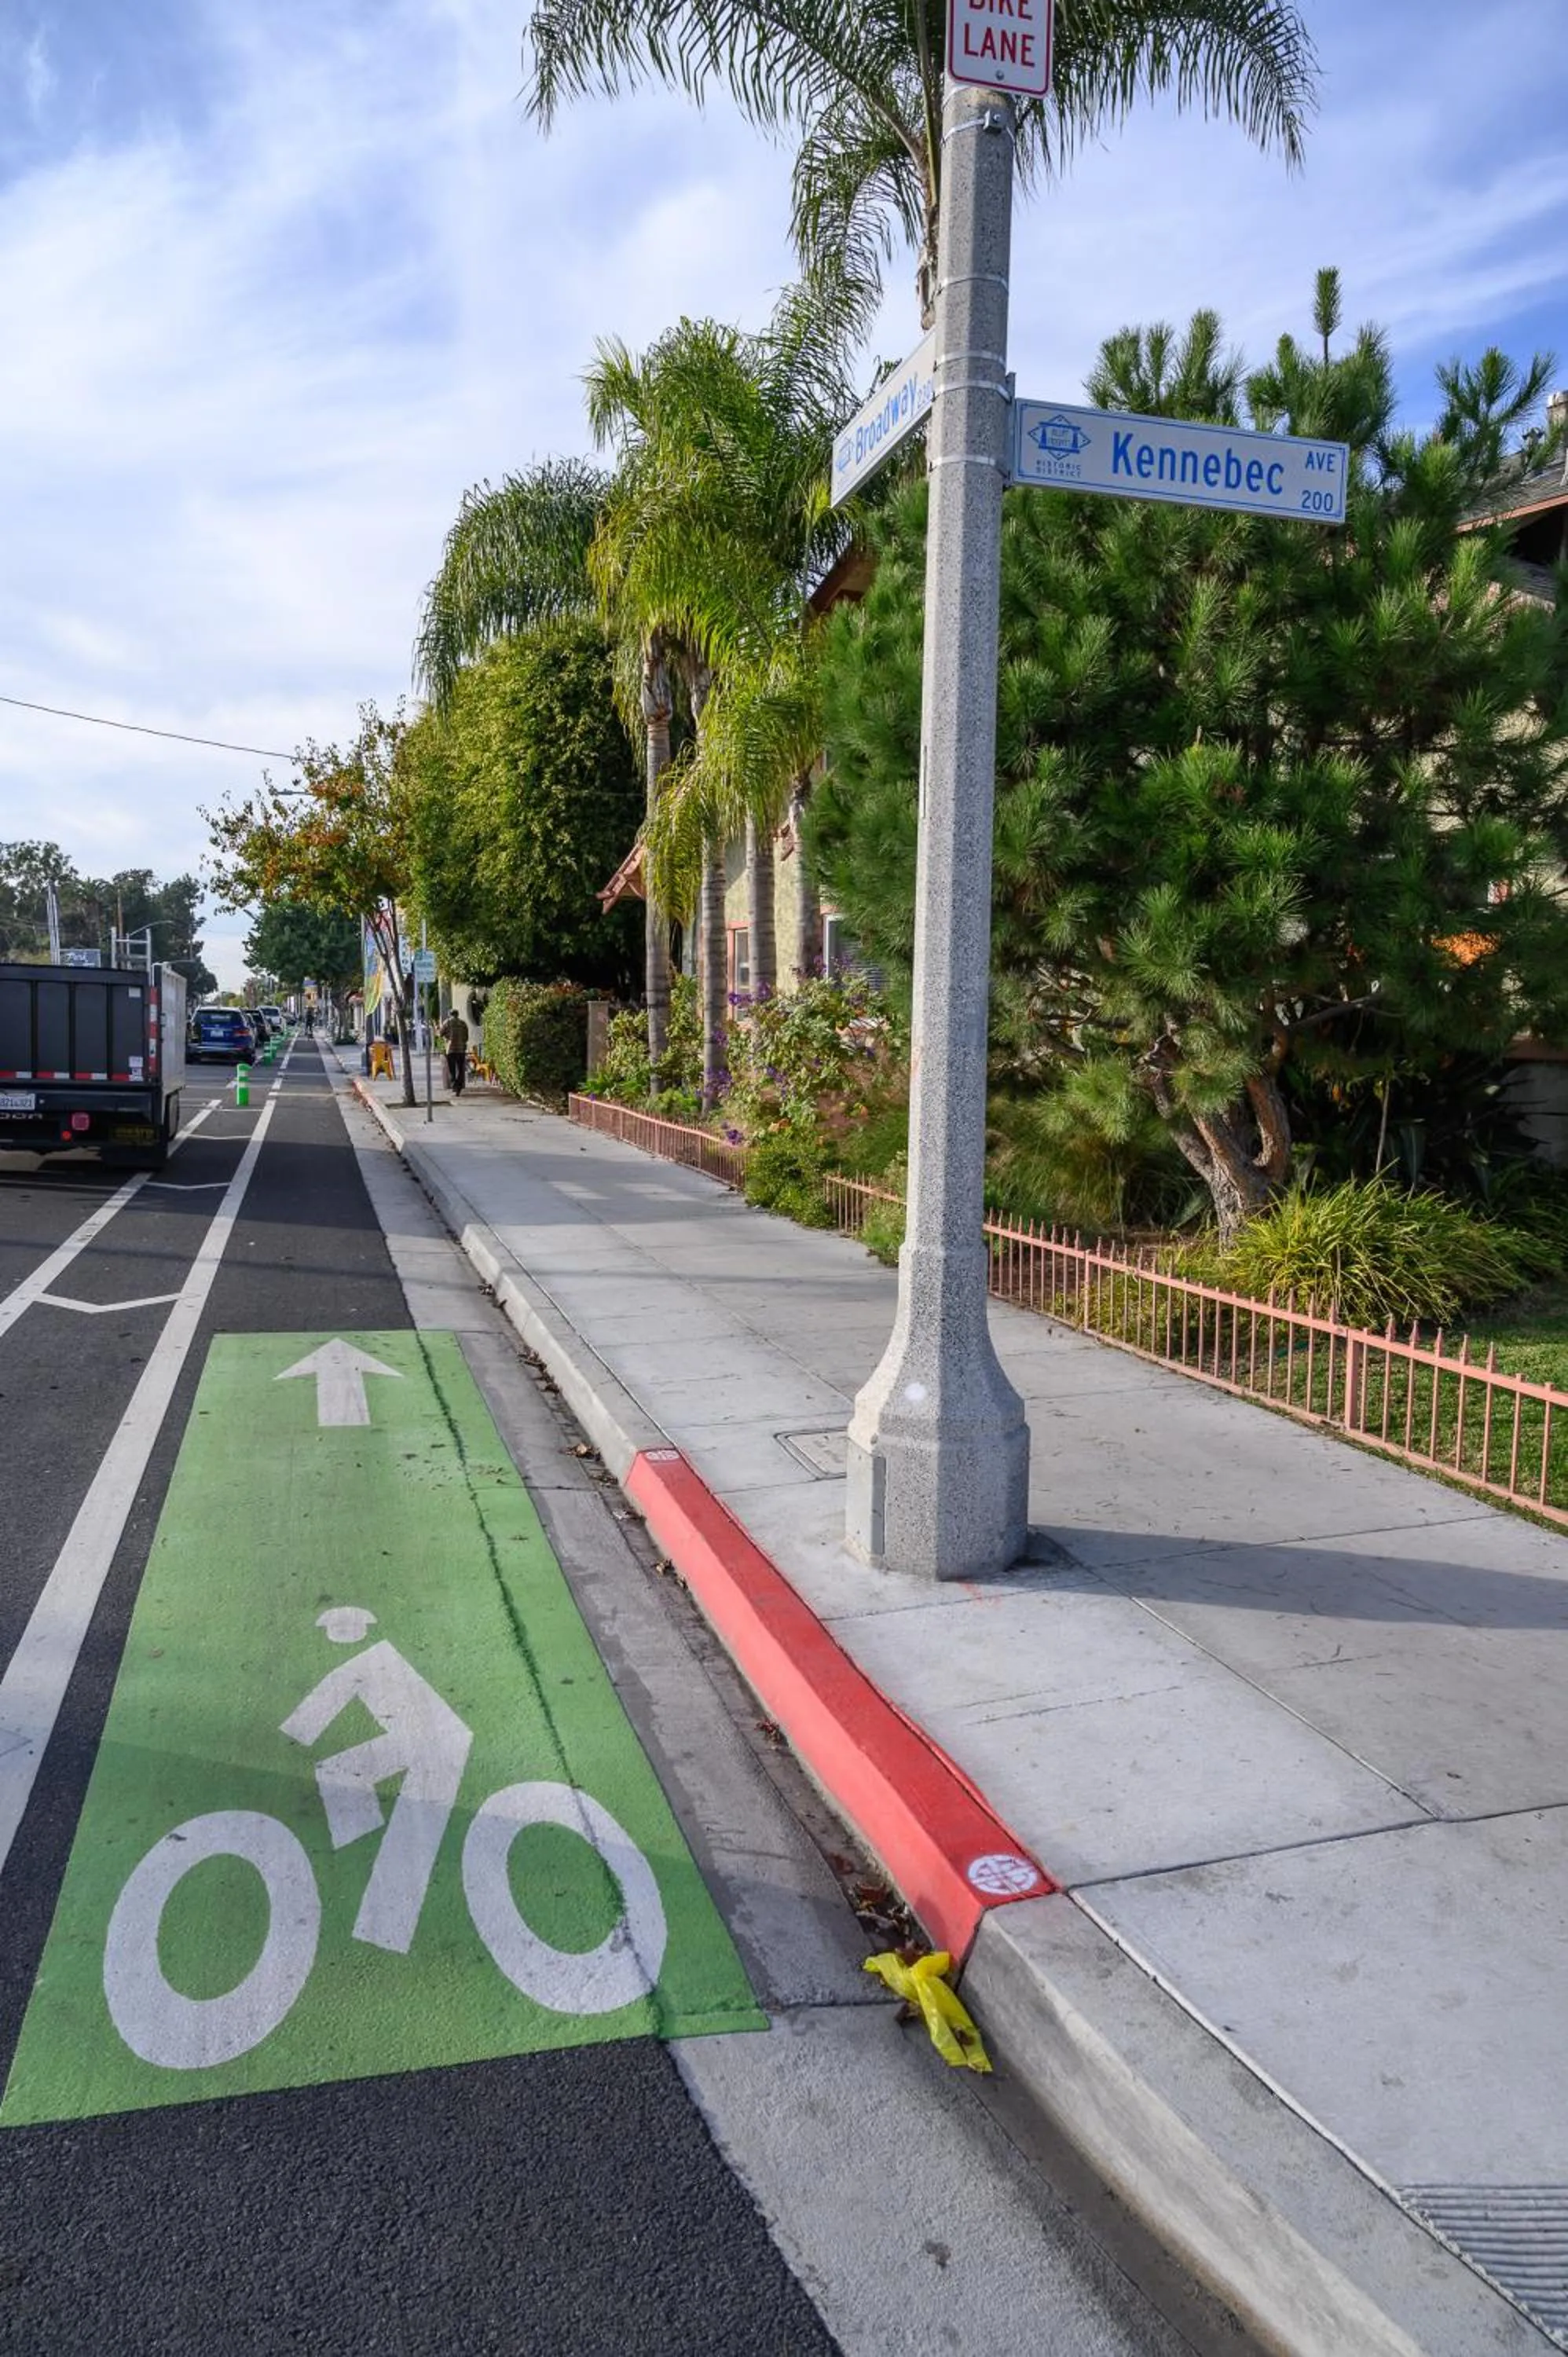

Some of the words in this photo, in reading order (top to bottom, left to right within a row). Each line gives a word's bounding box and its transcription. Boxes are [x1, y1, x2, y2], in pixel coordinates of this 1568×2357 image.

[968, 0, 1033, 20] KE
[964, 22, 1035, 68] LANE
[855, 371, 918, 466] Broadway
[1112, 431, 1284, 495] Kennebec
[1305, 450, 1336, 472] AVE
[1301, 489, 1334, 512] 200
